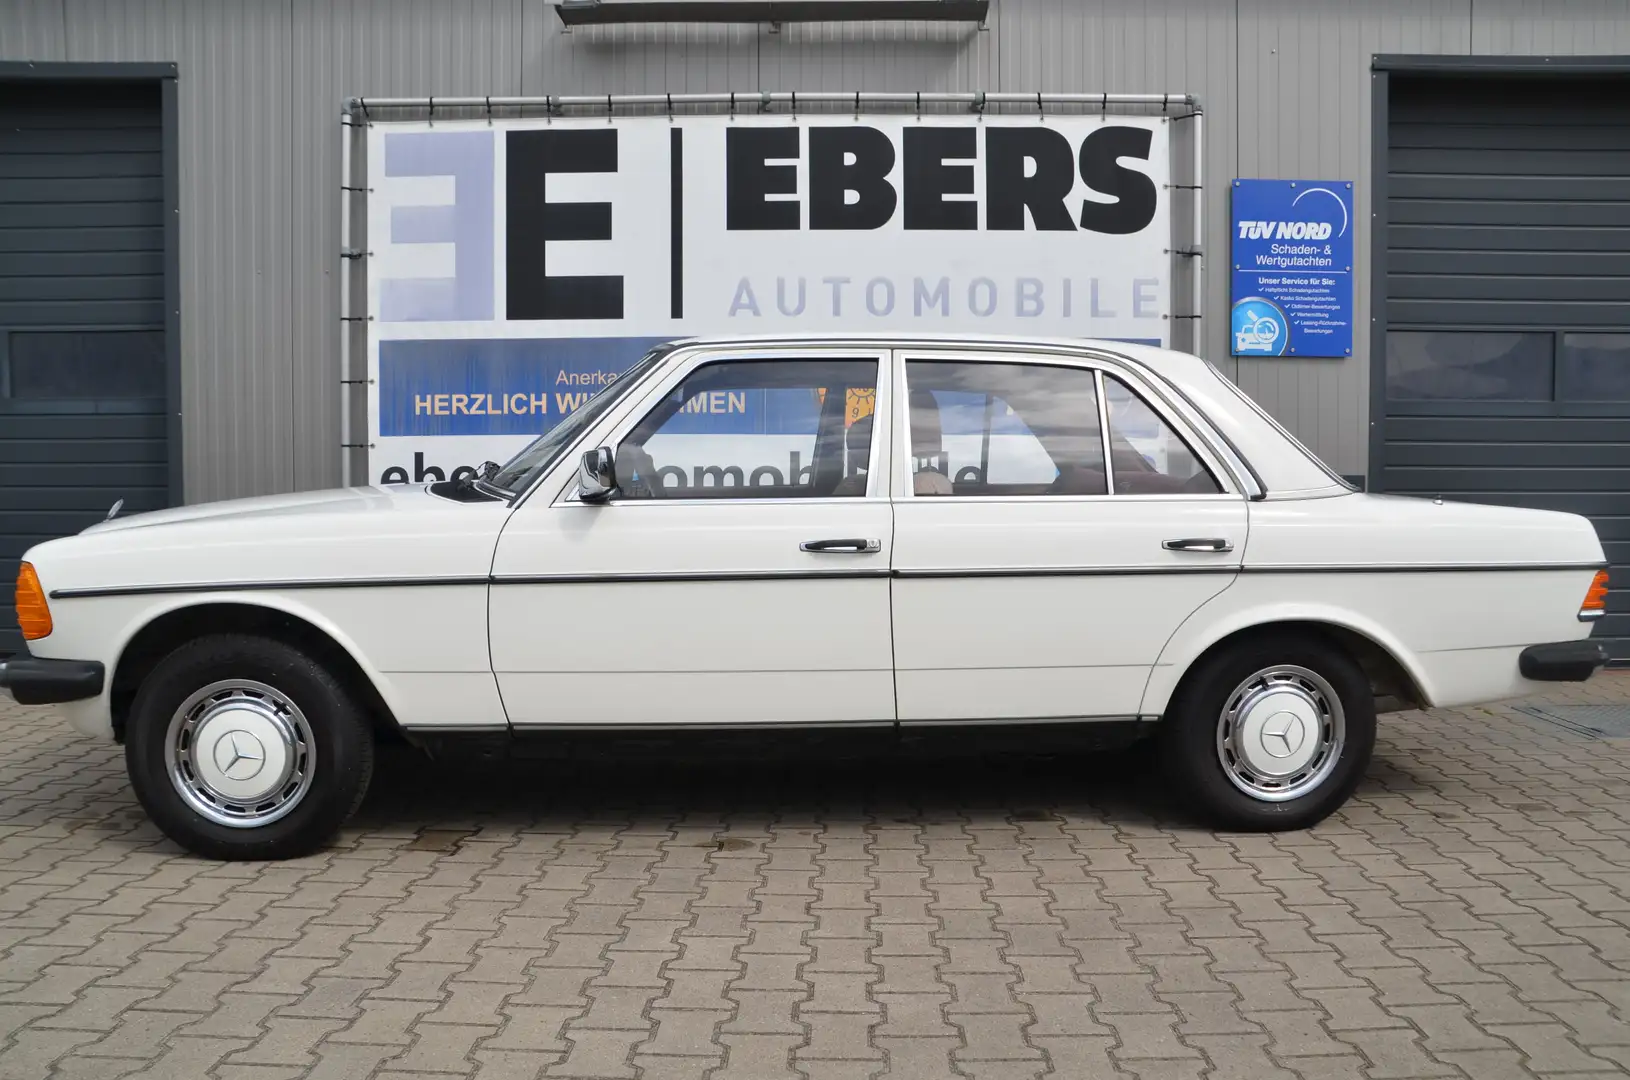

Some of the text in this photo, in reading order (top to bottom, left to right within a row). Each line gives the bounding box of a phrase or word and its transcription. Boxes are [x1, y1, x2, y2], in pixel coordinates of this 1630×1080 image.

[726, 125, 1158, 235] EBERS
[1238, 221, 1332, 240] TÜV NORD
[1270, 243, 1332, 255] Schaden- &
[1255, 255, 1332, 268] Wertgutachten
[1281, 277, 1308, 285] Service
[727, 276, 1160, 318] AUTOMOBILE
[555, 369, 619, 385] Anerka
[414, 392, 547, 415] HERZLICH
